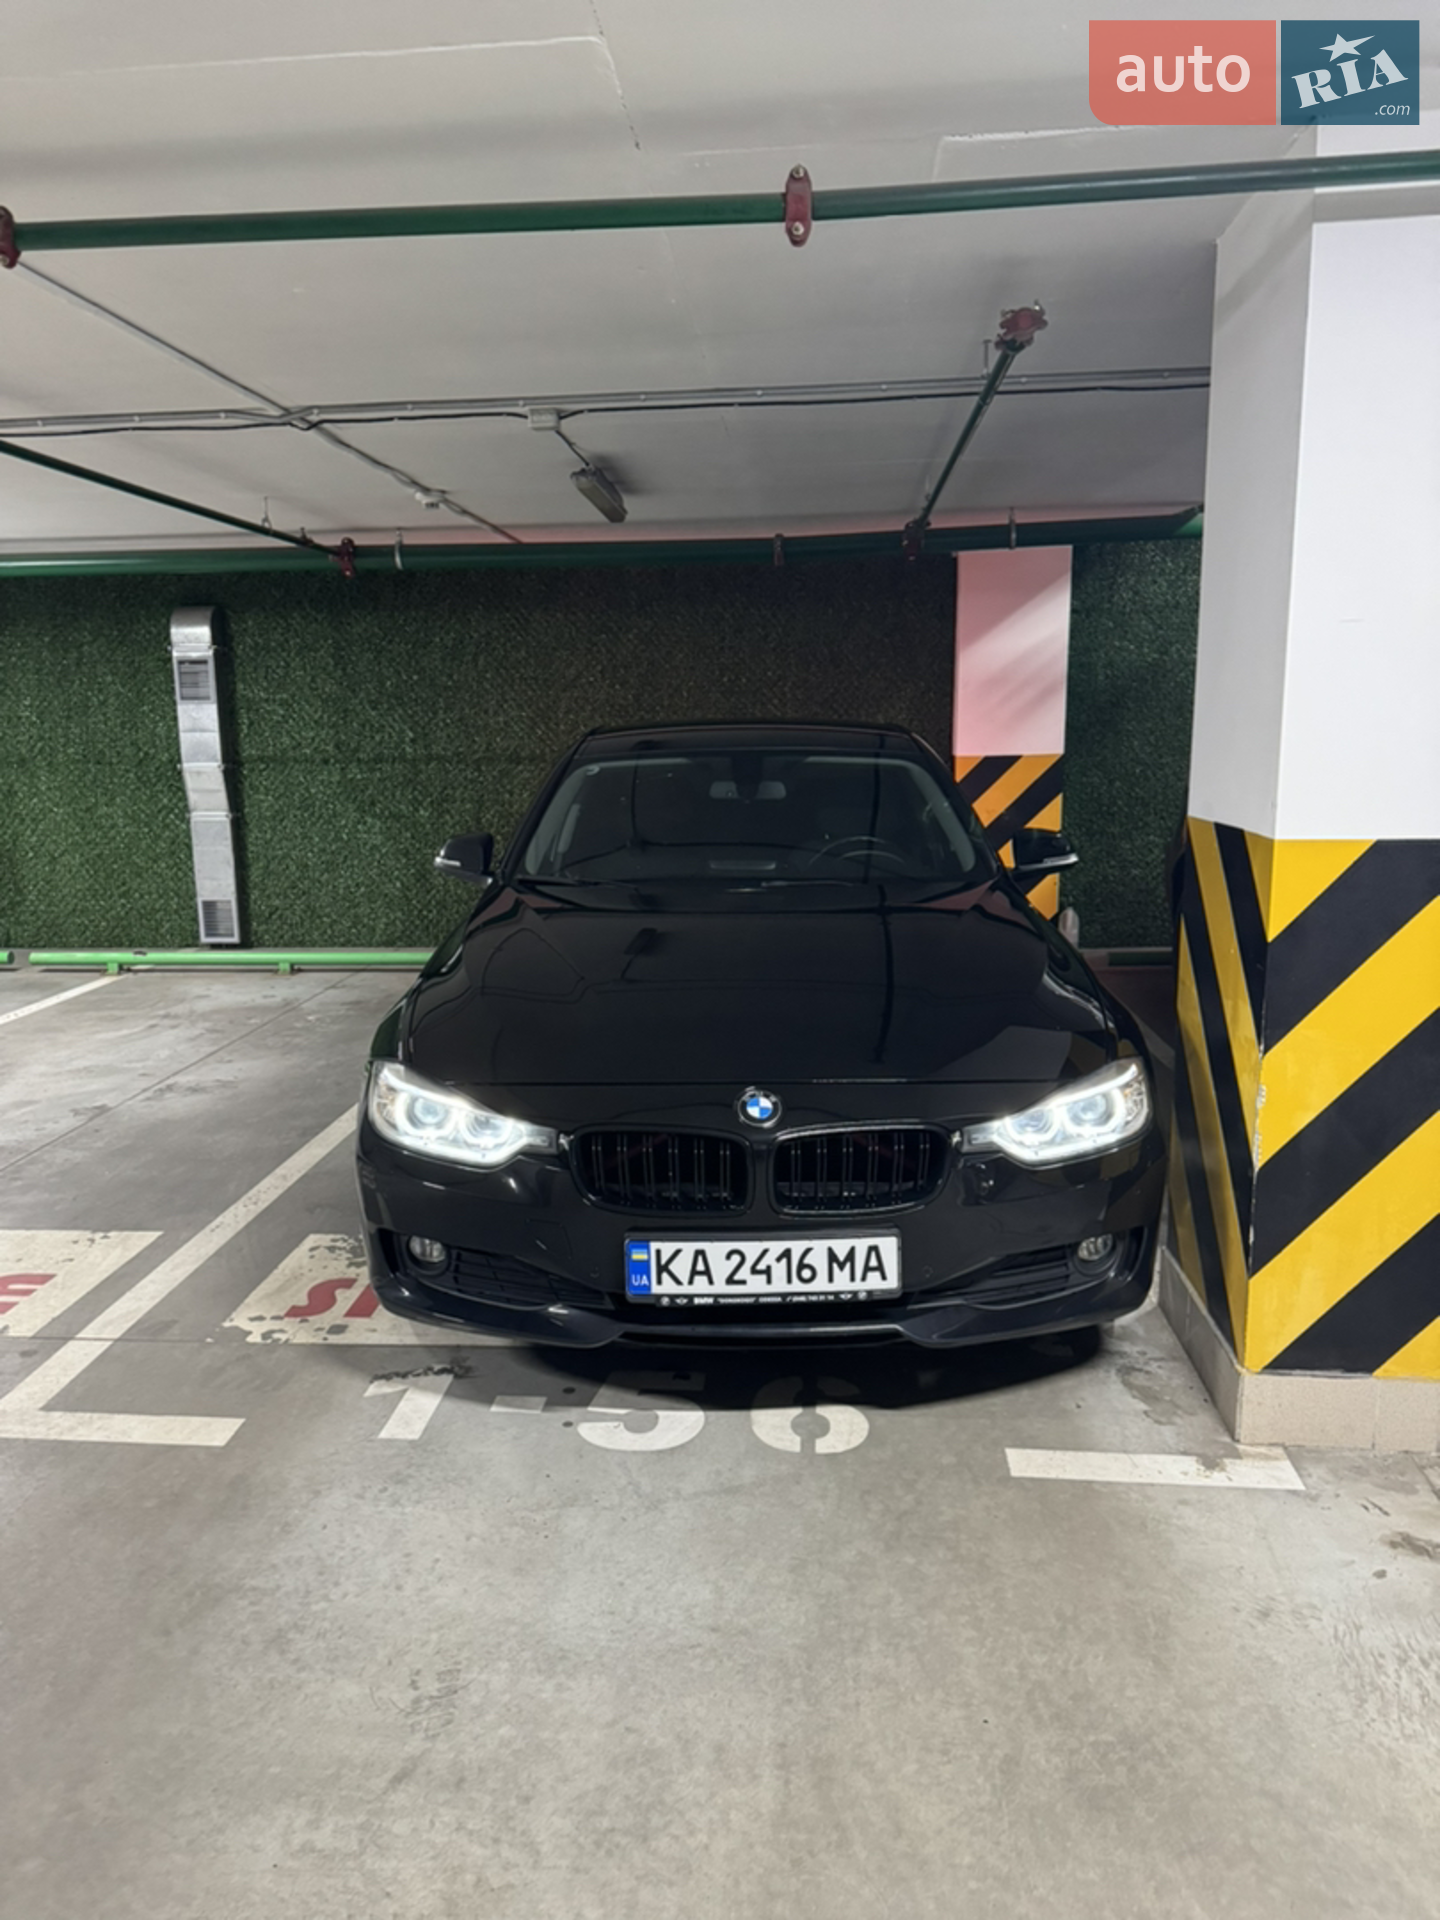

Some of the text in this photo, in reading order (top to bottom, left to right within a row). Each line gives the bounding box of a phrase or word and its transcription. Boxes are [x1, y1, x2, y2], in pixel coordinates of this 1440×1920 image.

[655, 1244, 888, 1286] KA 2416 MA
[631, 1274, 650, 1287] UA
